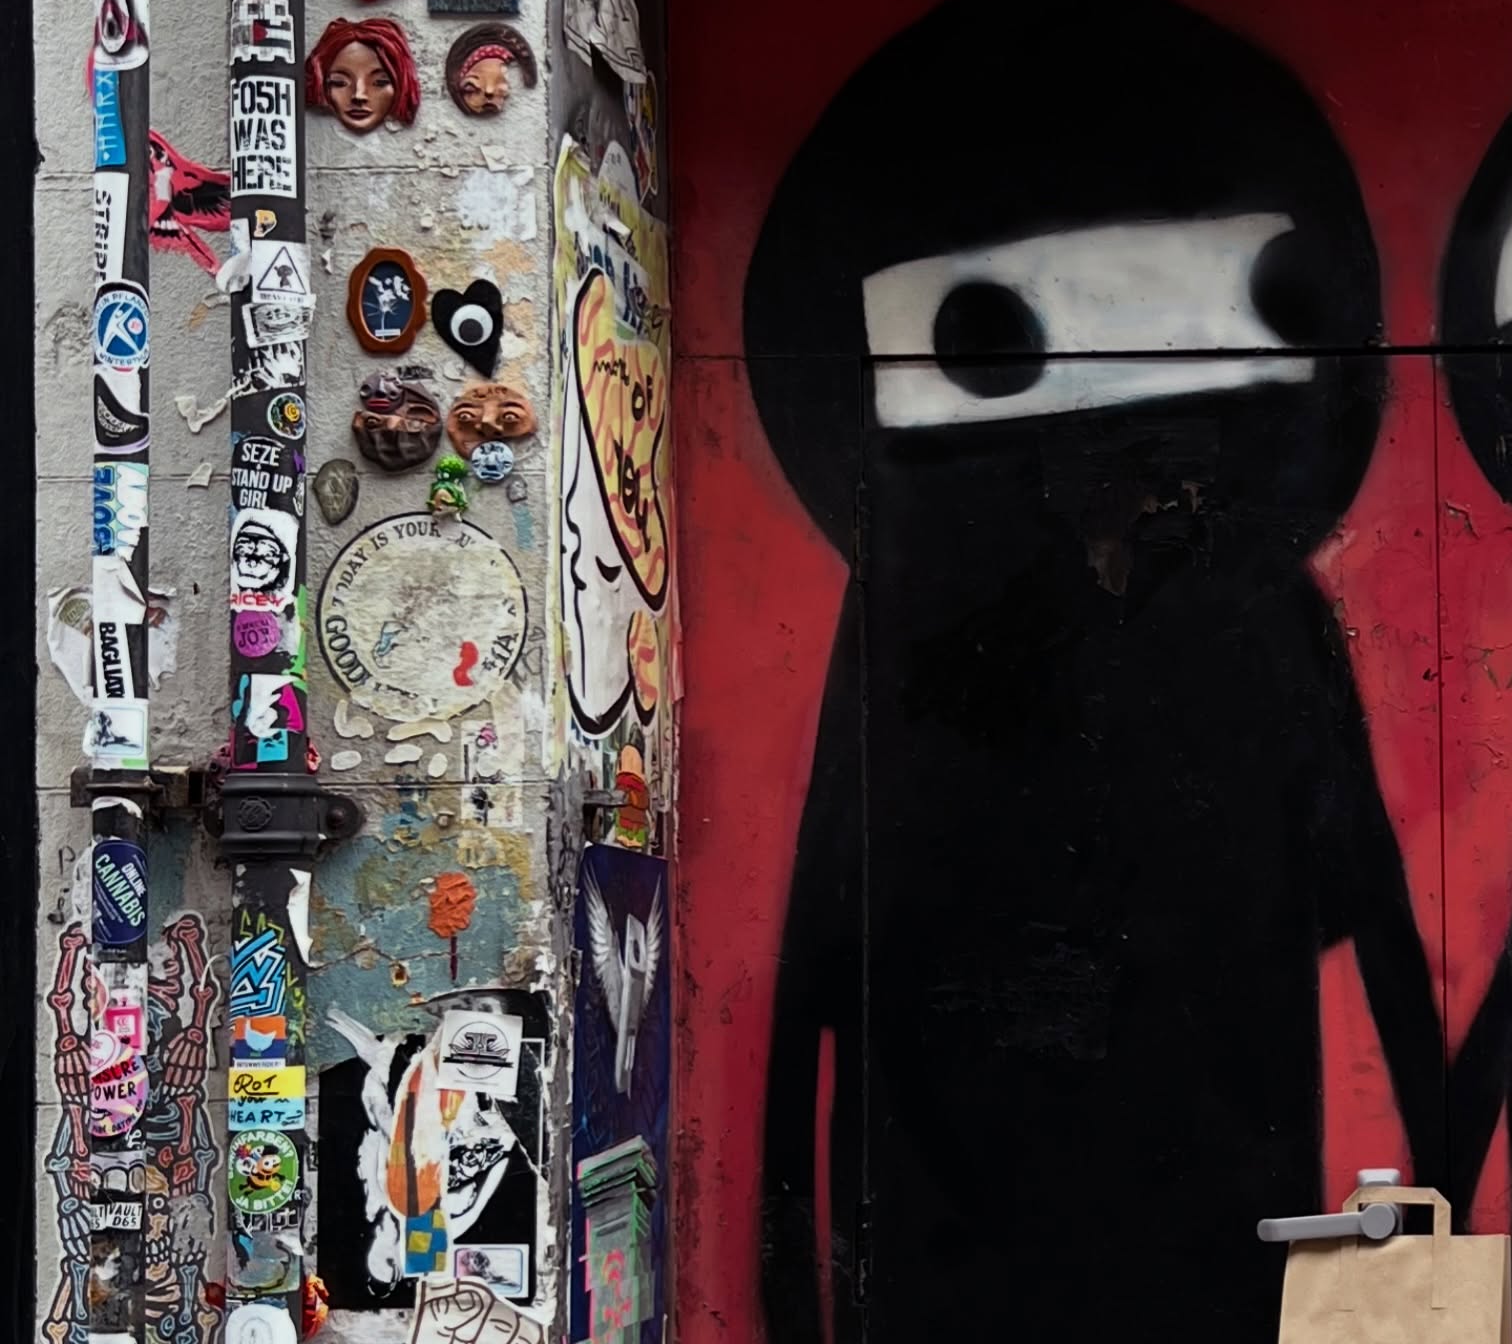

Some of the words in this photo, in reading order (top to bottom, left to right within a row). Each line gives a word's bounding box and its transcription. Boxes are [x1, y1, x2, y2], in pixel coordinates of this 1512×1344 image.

[234, 119, 287, 152] WAS
[231, 467, 270, 490] STAND
[272, 473, 293, 494] UP
[94, 853, 146, 927] CANNABIS
[120, 862, 147, 898] ONLINE
